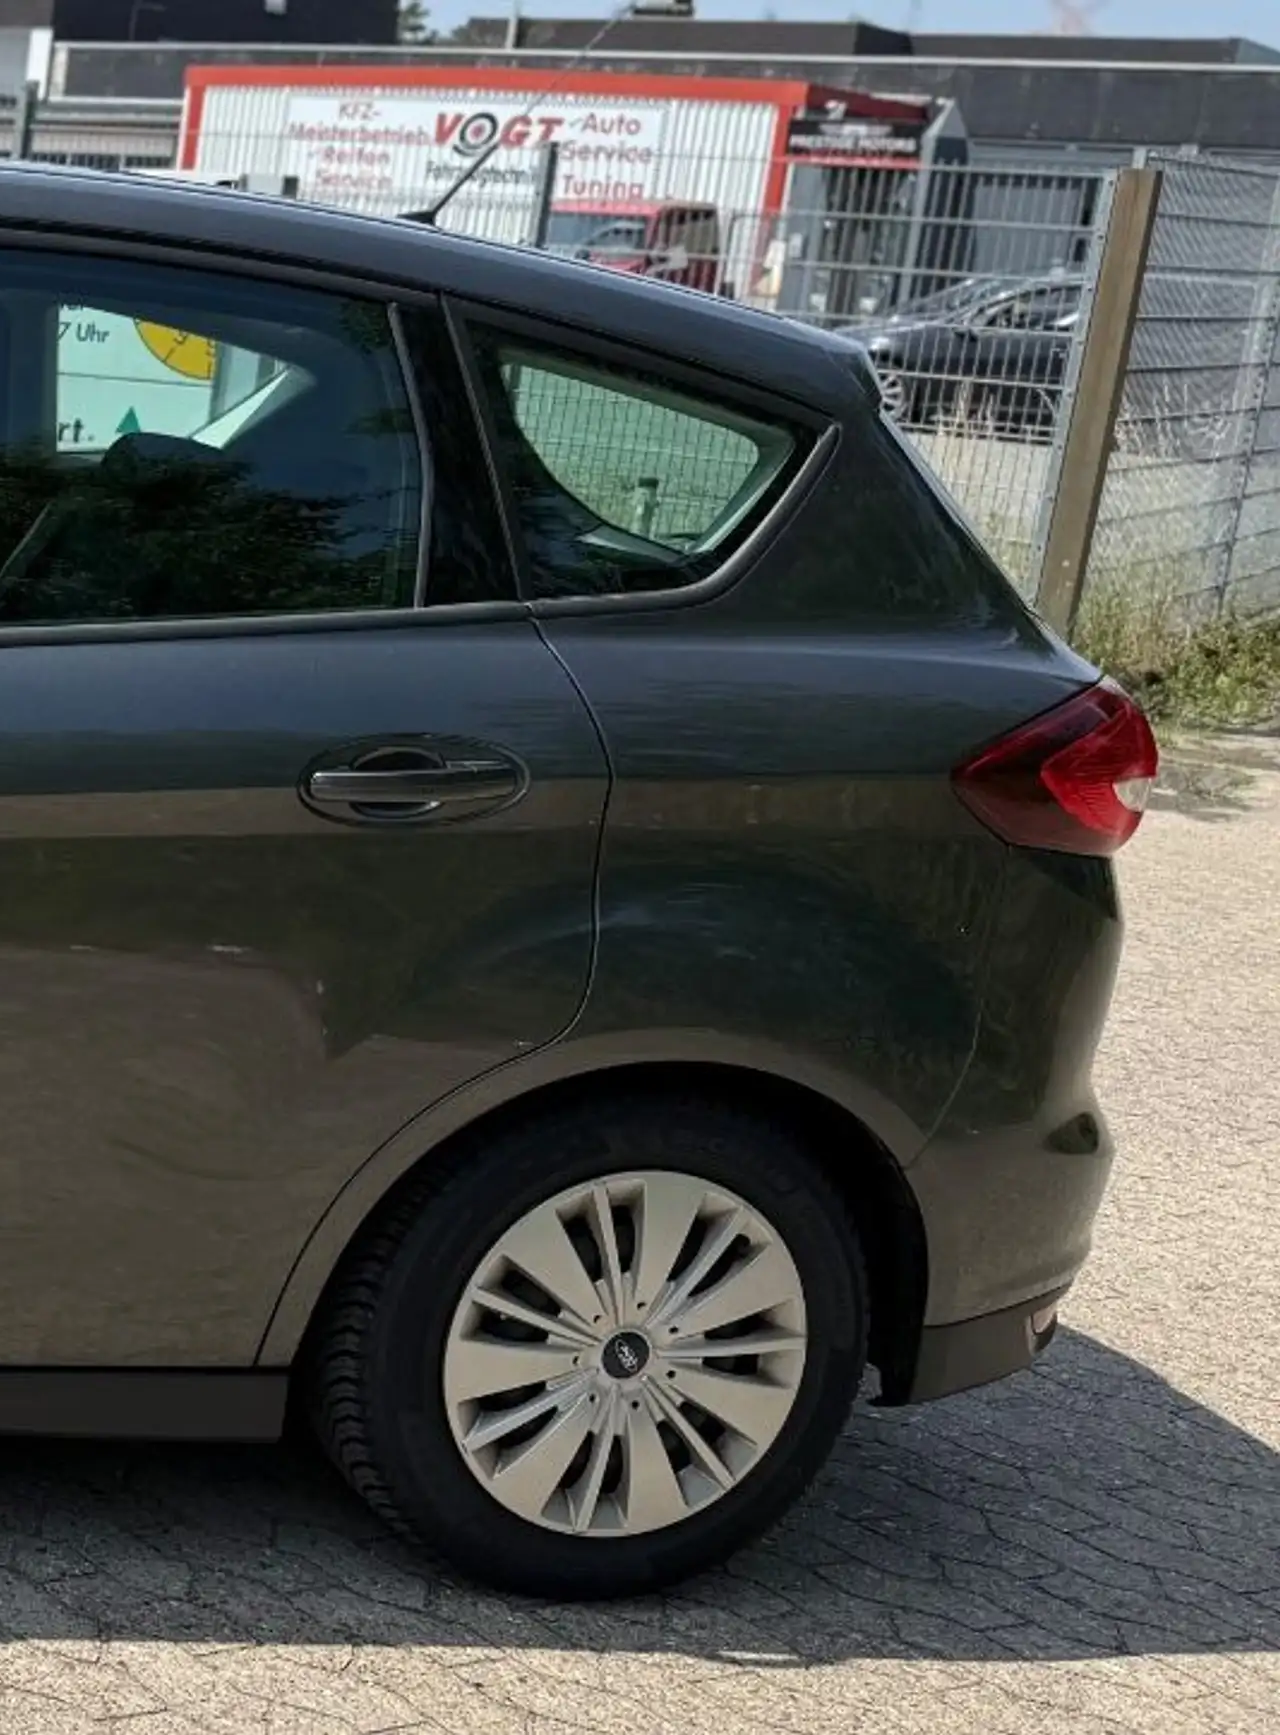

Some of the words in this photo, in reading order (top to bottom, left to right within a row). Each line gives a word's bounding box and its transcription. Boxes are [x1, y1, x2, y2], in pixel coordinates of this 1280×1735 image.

[289, 122, 431, 146] Meisterbetrieb
[435, 112, 563, 150] VOGT
[581, 112, 642, 136] Auto
[560, 140, 652, 164] Service
[563, 174, 645, 200] Tuning
[76, 320, 110, 343] Uhr
